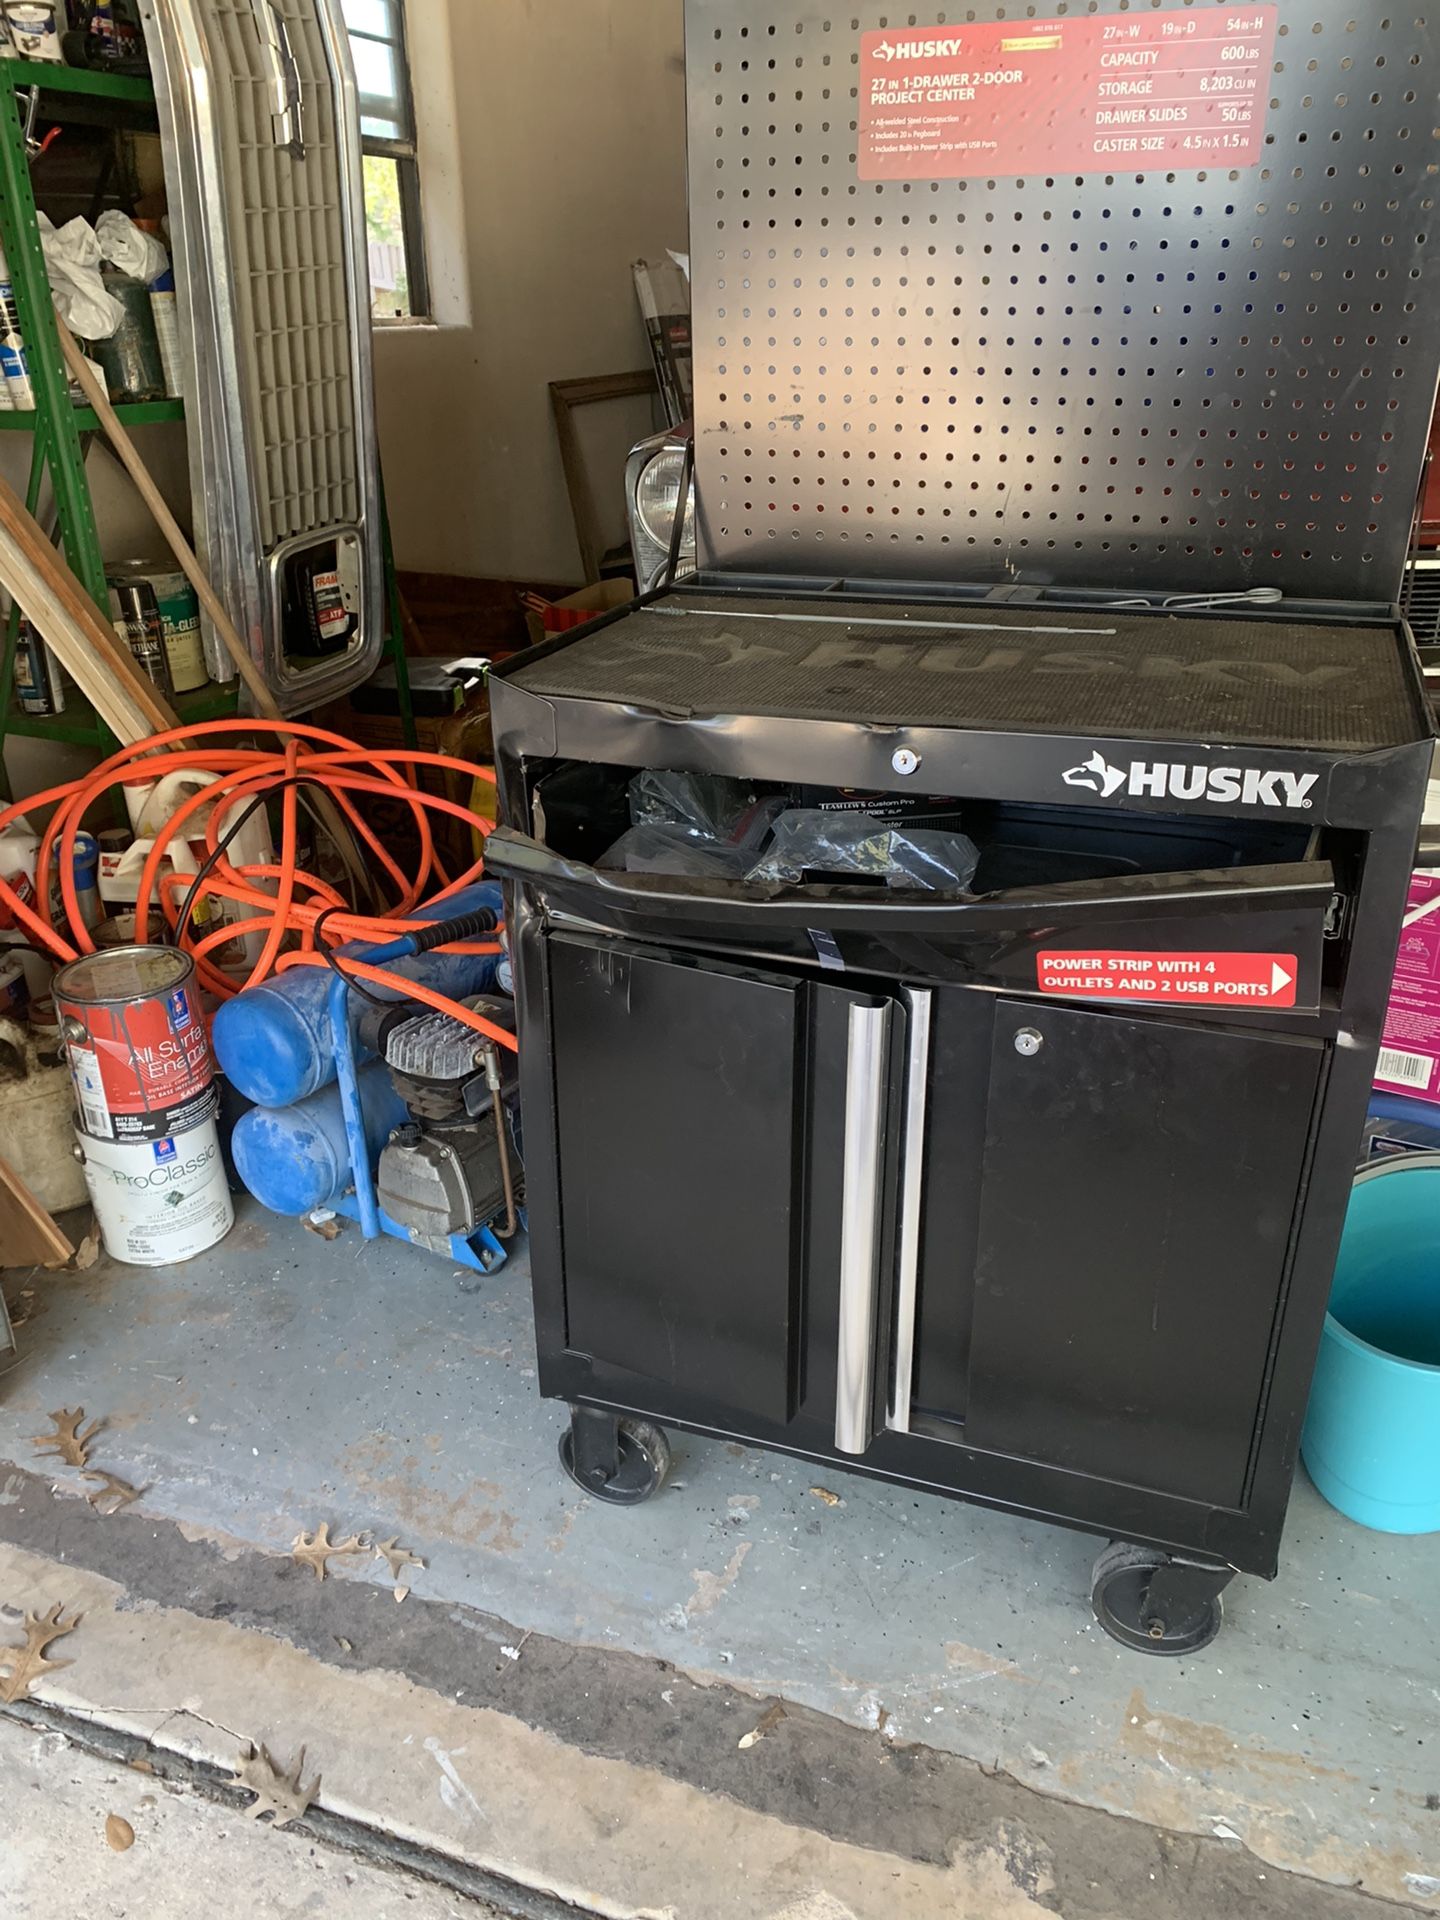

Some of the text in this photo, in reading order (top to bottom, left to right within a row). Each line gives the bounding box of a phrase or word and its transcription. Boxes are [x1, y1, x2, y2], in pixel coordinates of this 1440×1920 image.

[896, 39, 962, 59] HUSKY
[1100, 50, 1159, 67] CAPACITY
[871, 70, 1023, 91] 27 IN 1-DRAWER 2-DOOR
[1098, 79, 1153, 96] STORAGE
[1200, 76, 1233, 93] 8,203
[1234, 79, 1246, 90] CU
[871, 88, 975, 105] PROJECT CENTER
[1095, 110, 1146, 125] DRAWER
[1148, 107, 1188, 121] SLIDES
[1221, 108, 1237, 122] 50
[1093, 138, 1137, 153] CASTER
[1140, 137, 1165, 151] SIZE
[800, 641, 1360, 687] HUSKY
[1128, 761, 1321, 808] HUSKY
[867, 800, 900, 808] Custom
[1043, 958, 1216, 973] POWER STRIP WITH 4
[1044, 976, 1269, 996] OUTLETS AND 2 USB PORTS
[128, 1047, 153, 1066] All
[112, 1143, 217, 1190] ProClassic
